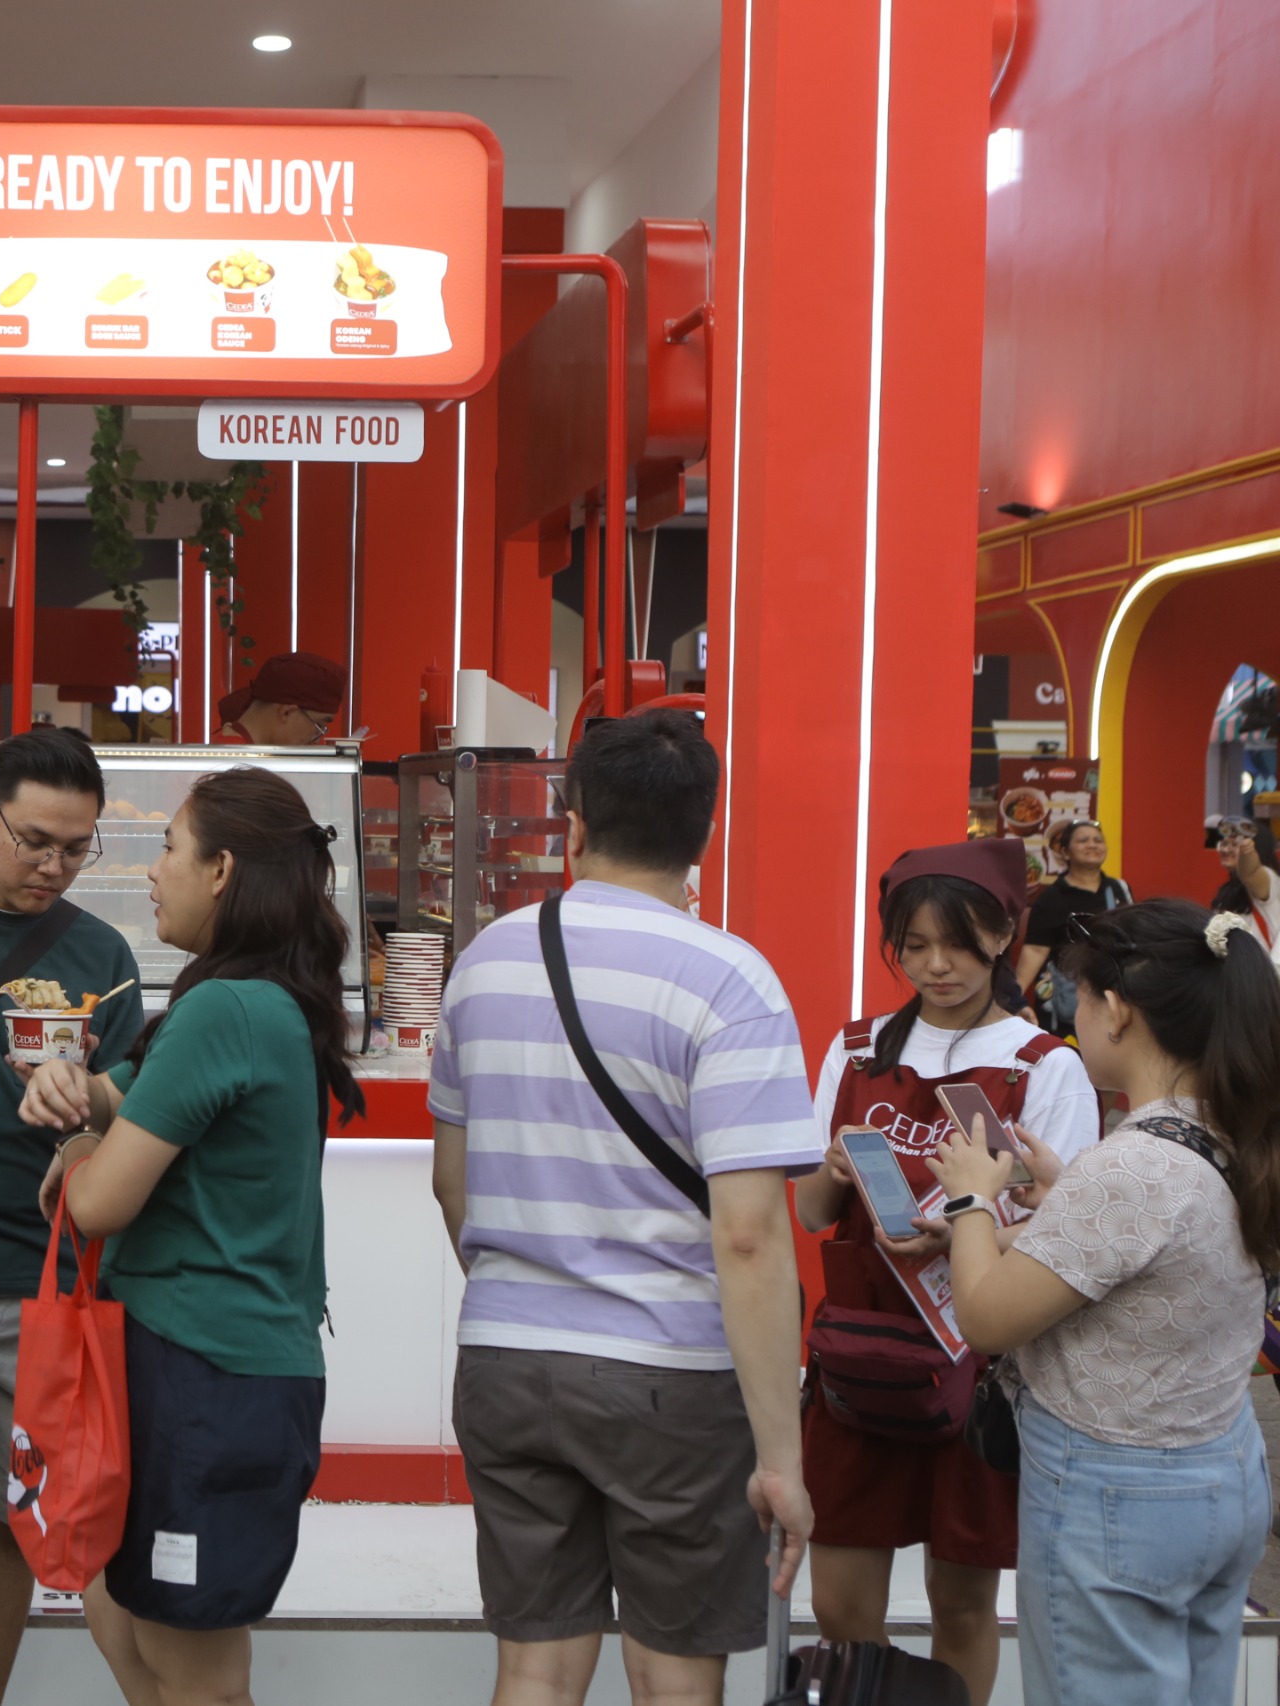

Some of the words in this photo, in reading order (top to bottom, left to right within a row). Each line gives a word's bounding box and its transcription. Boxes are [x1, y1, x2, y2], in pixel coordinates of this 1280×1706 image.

[136, 156, 191, 213] TO
[205, 158, 355, 217] ENJOY!
[217, 332, 252, 340] KOREAN
[335, 327, 372, 336] KOREAN
[217, 340, 245, 348] SAUCE
[219, 414, 322, 445] KOREAN
[334, 415, 400, 446] FOOD
[15, 1034, 40, 1045] CEDEA
